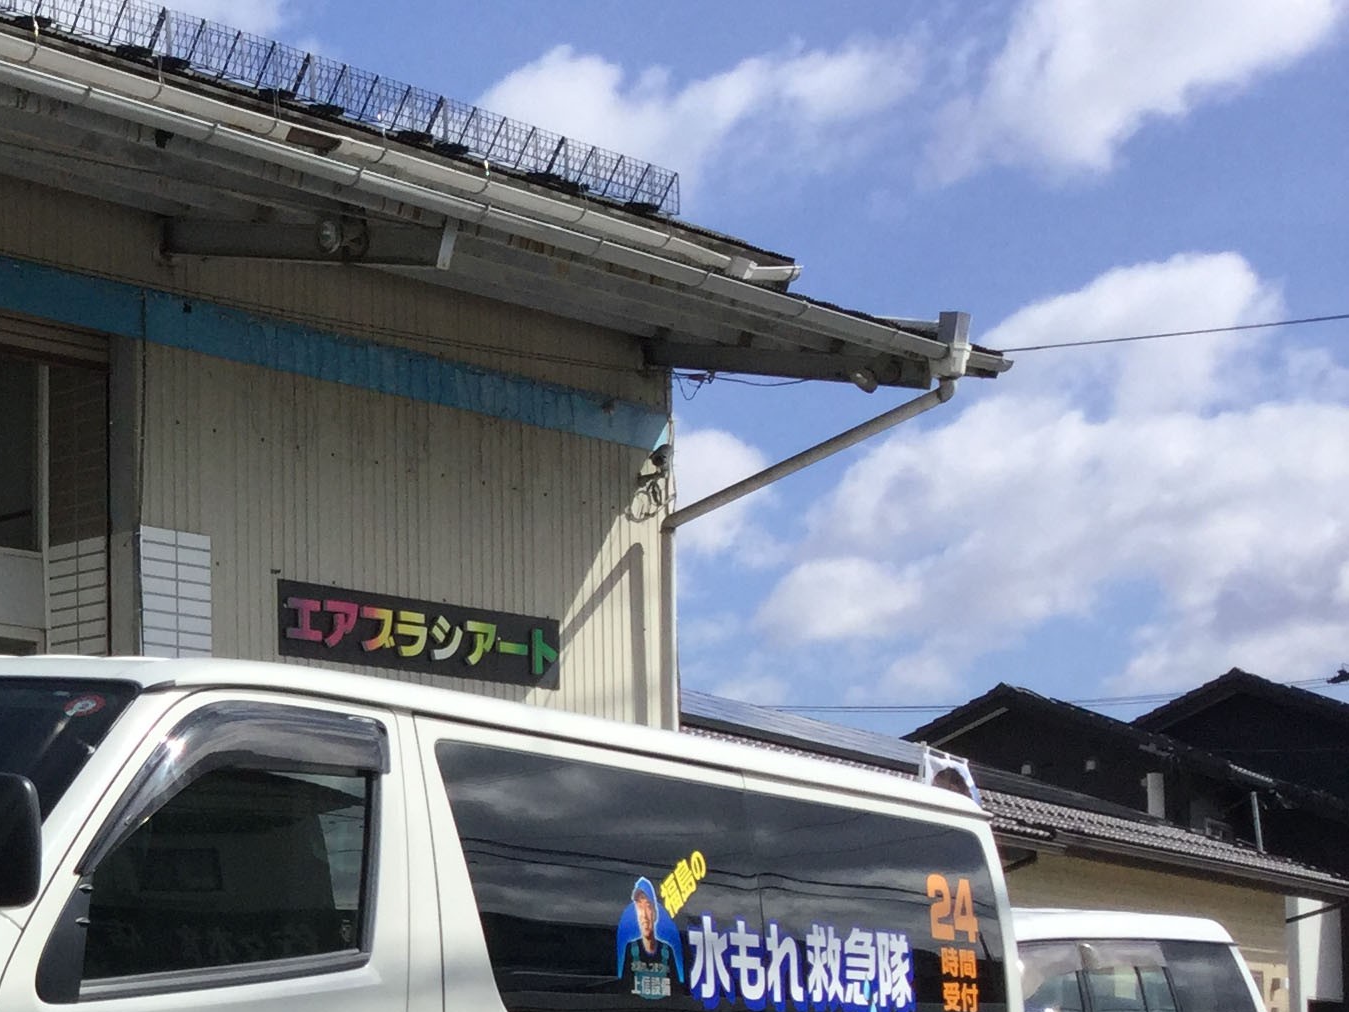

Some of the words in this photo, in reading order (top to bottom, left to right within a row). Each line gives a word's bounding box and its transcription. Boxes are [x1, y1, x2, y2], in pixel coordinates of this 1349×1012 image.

[283, 596, 560, 676] エアブラシアート
[659, 850, 707, 919] 福島の
[926, 873, 979, 943] 24
[940, 947, 978, 979] 時間
